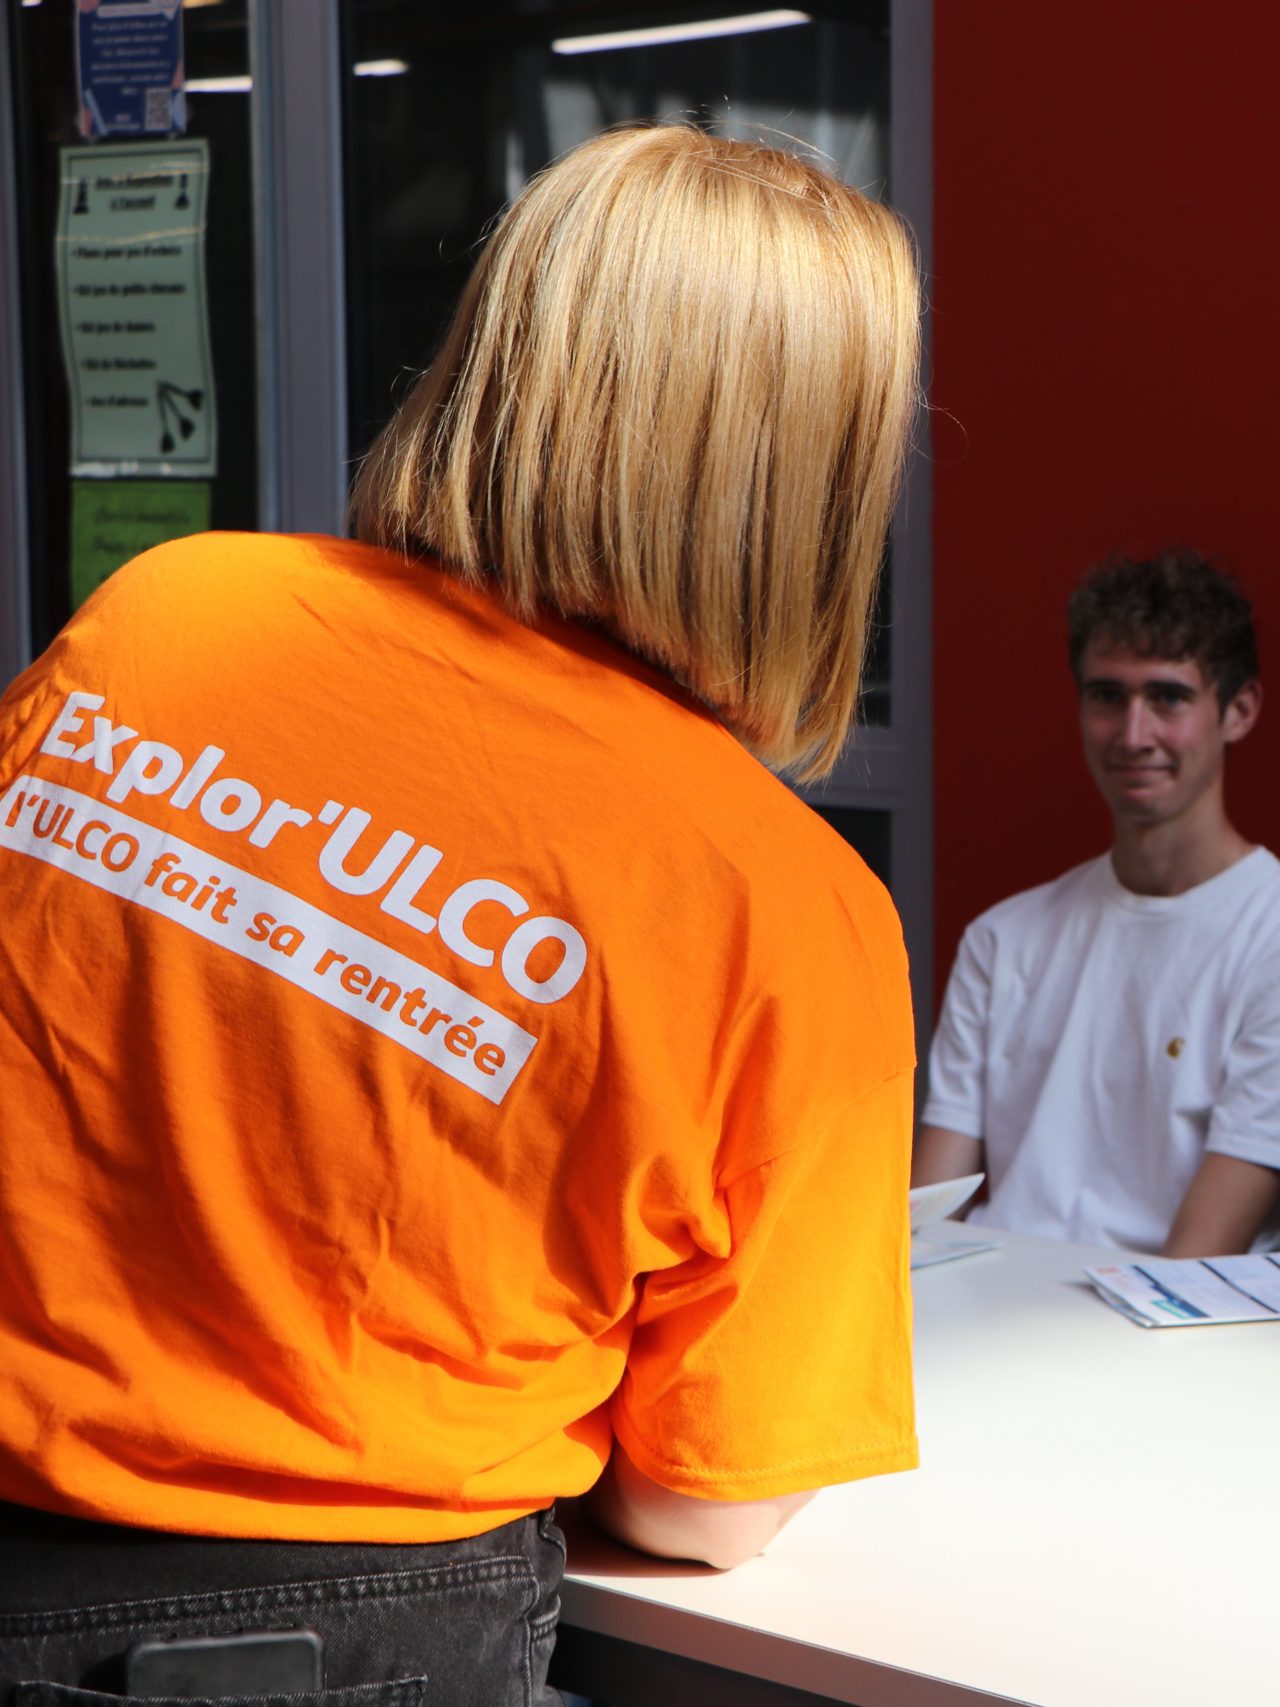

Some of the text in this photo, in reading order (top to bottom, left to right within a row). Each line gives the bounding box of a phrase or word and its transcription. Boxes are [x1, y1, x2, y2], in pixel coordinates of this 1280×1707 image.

[40, 690, 588, 1005] Explor'ULCO
[144, 852, 238, 925] fait
[245, 911, 305, 957] sa
[313, 948, 506, 1076] rentrée
